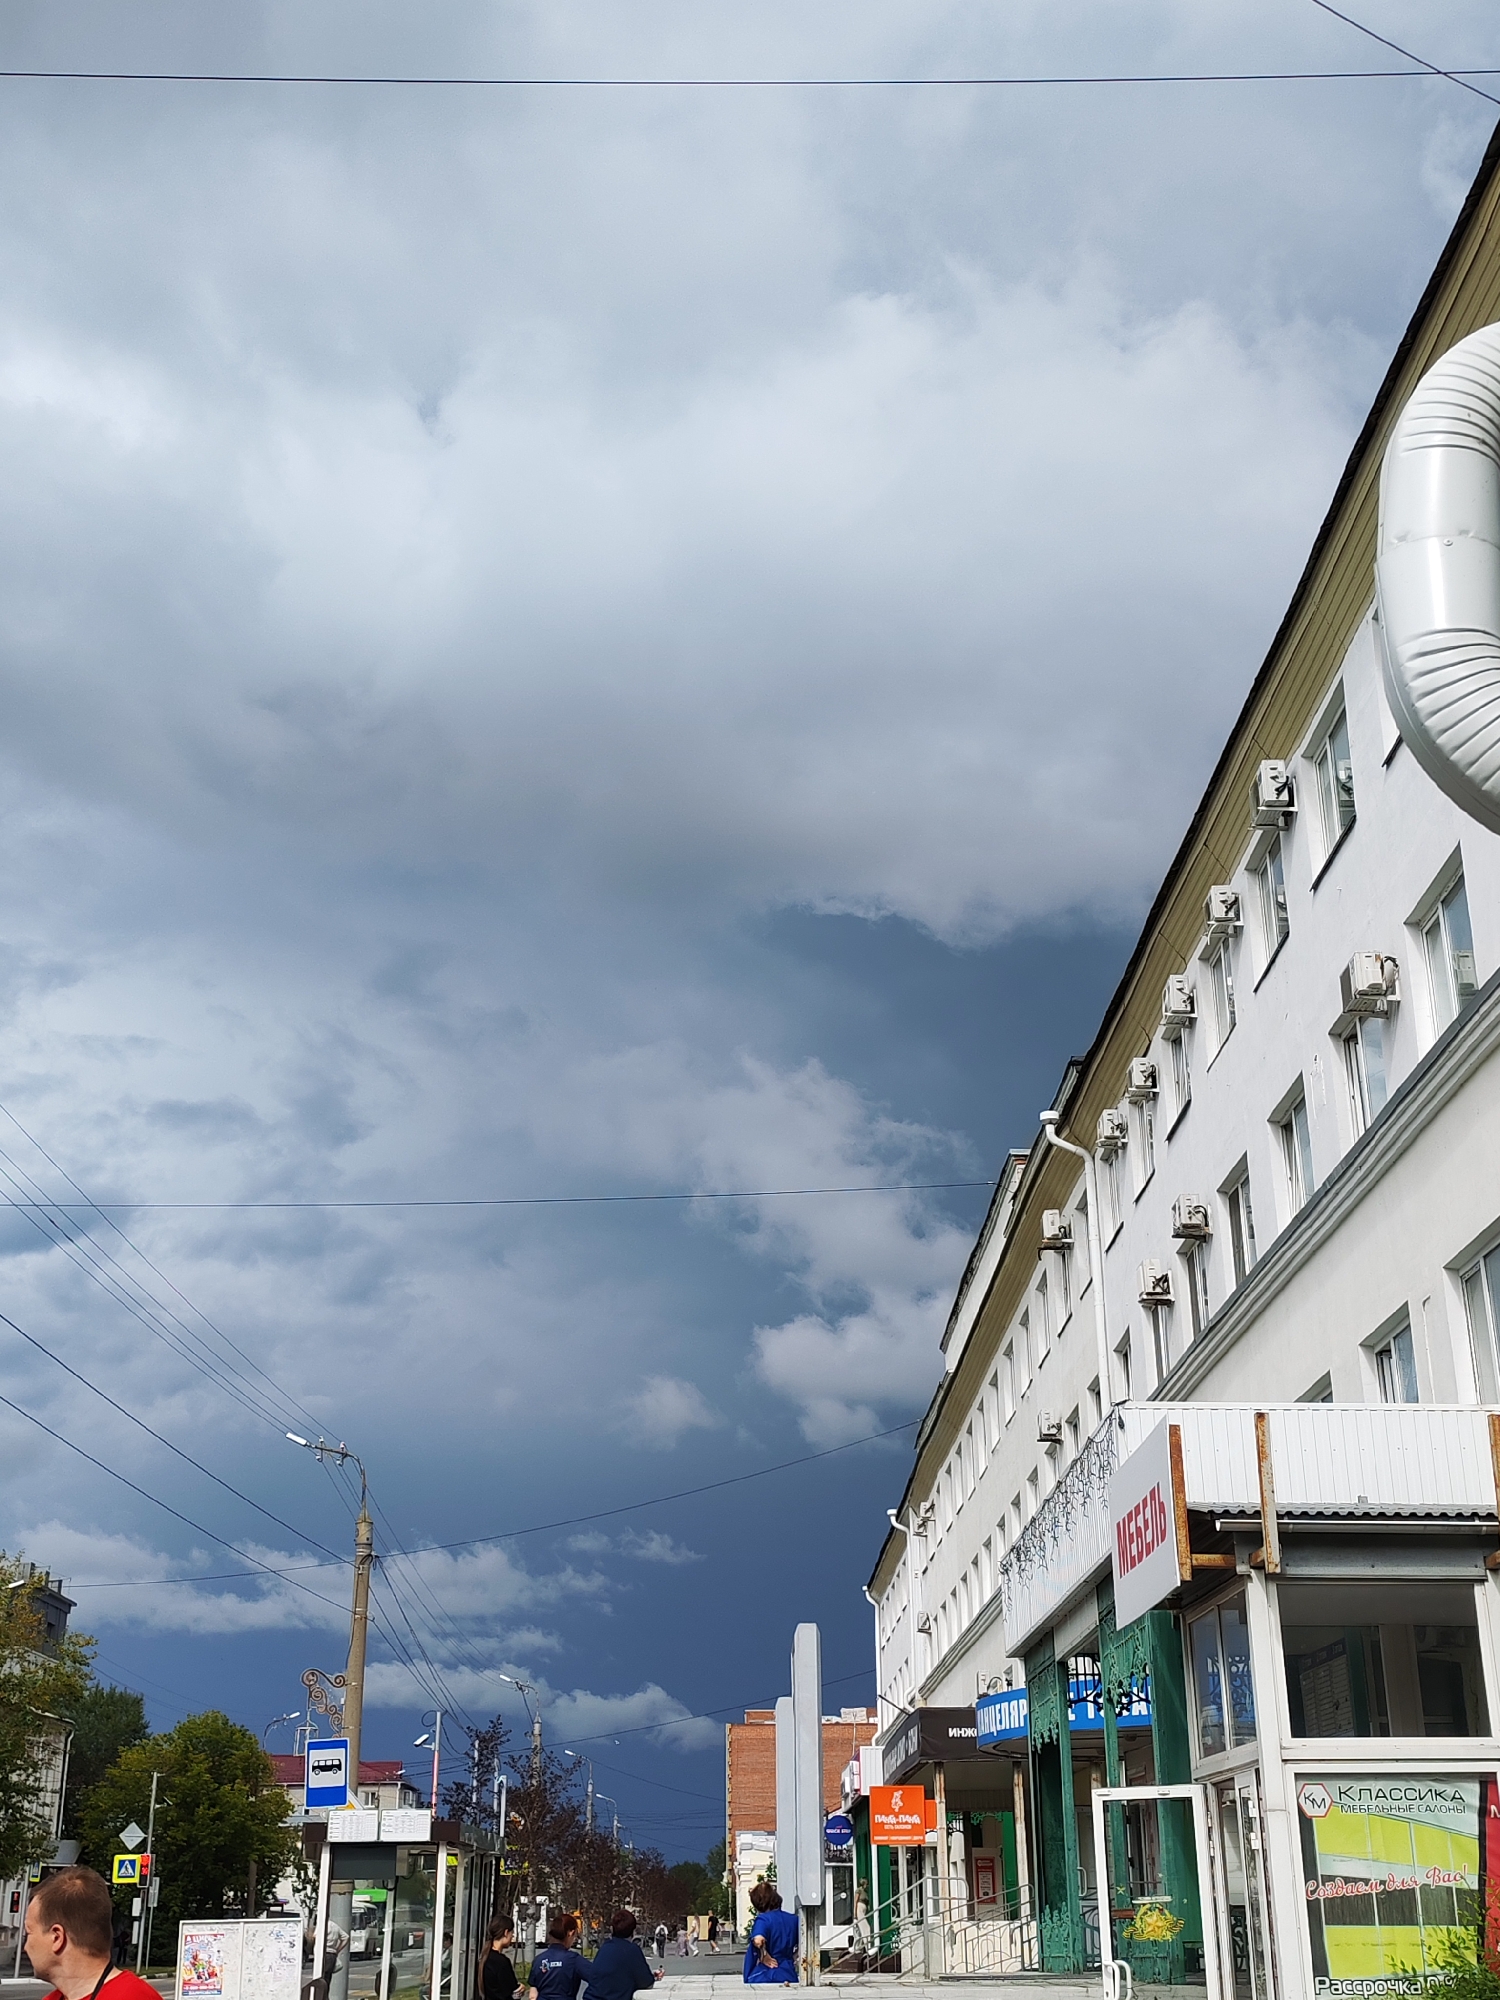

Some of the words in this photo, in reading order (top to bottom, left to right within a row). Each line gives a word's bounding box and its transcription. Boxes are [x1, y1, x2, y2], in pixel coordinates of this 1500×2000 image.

[1116, 1481, 1167, 1579] МЕБЕЛЬ
[948, 1727, 977, 1738] ИНЖ
[1341, 1804, 1415, 1814] МЕБЕЛЬНЫЕ
[1418, 1804, 1466, 1813] САЛОНЫ
[1306, 1878, 1382, 1898] Создаем
[1386, 1872, 1421, 1890] для
[1315, 1976, 1422, 1998] Рассрочка
